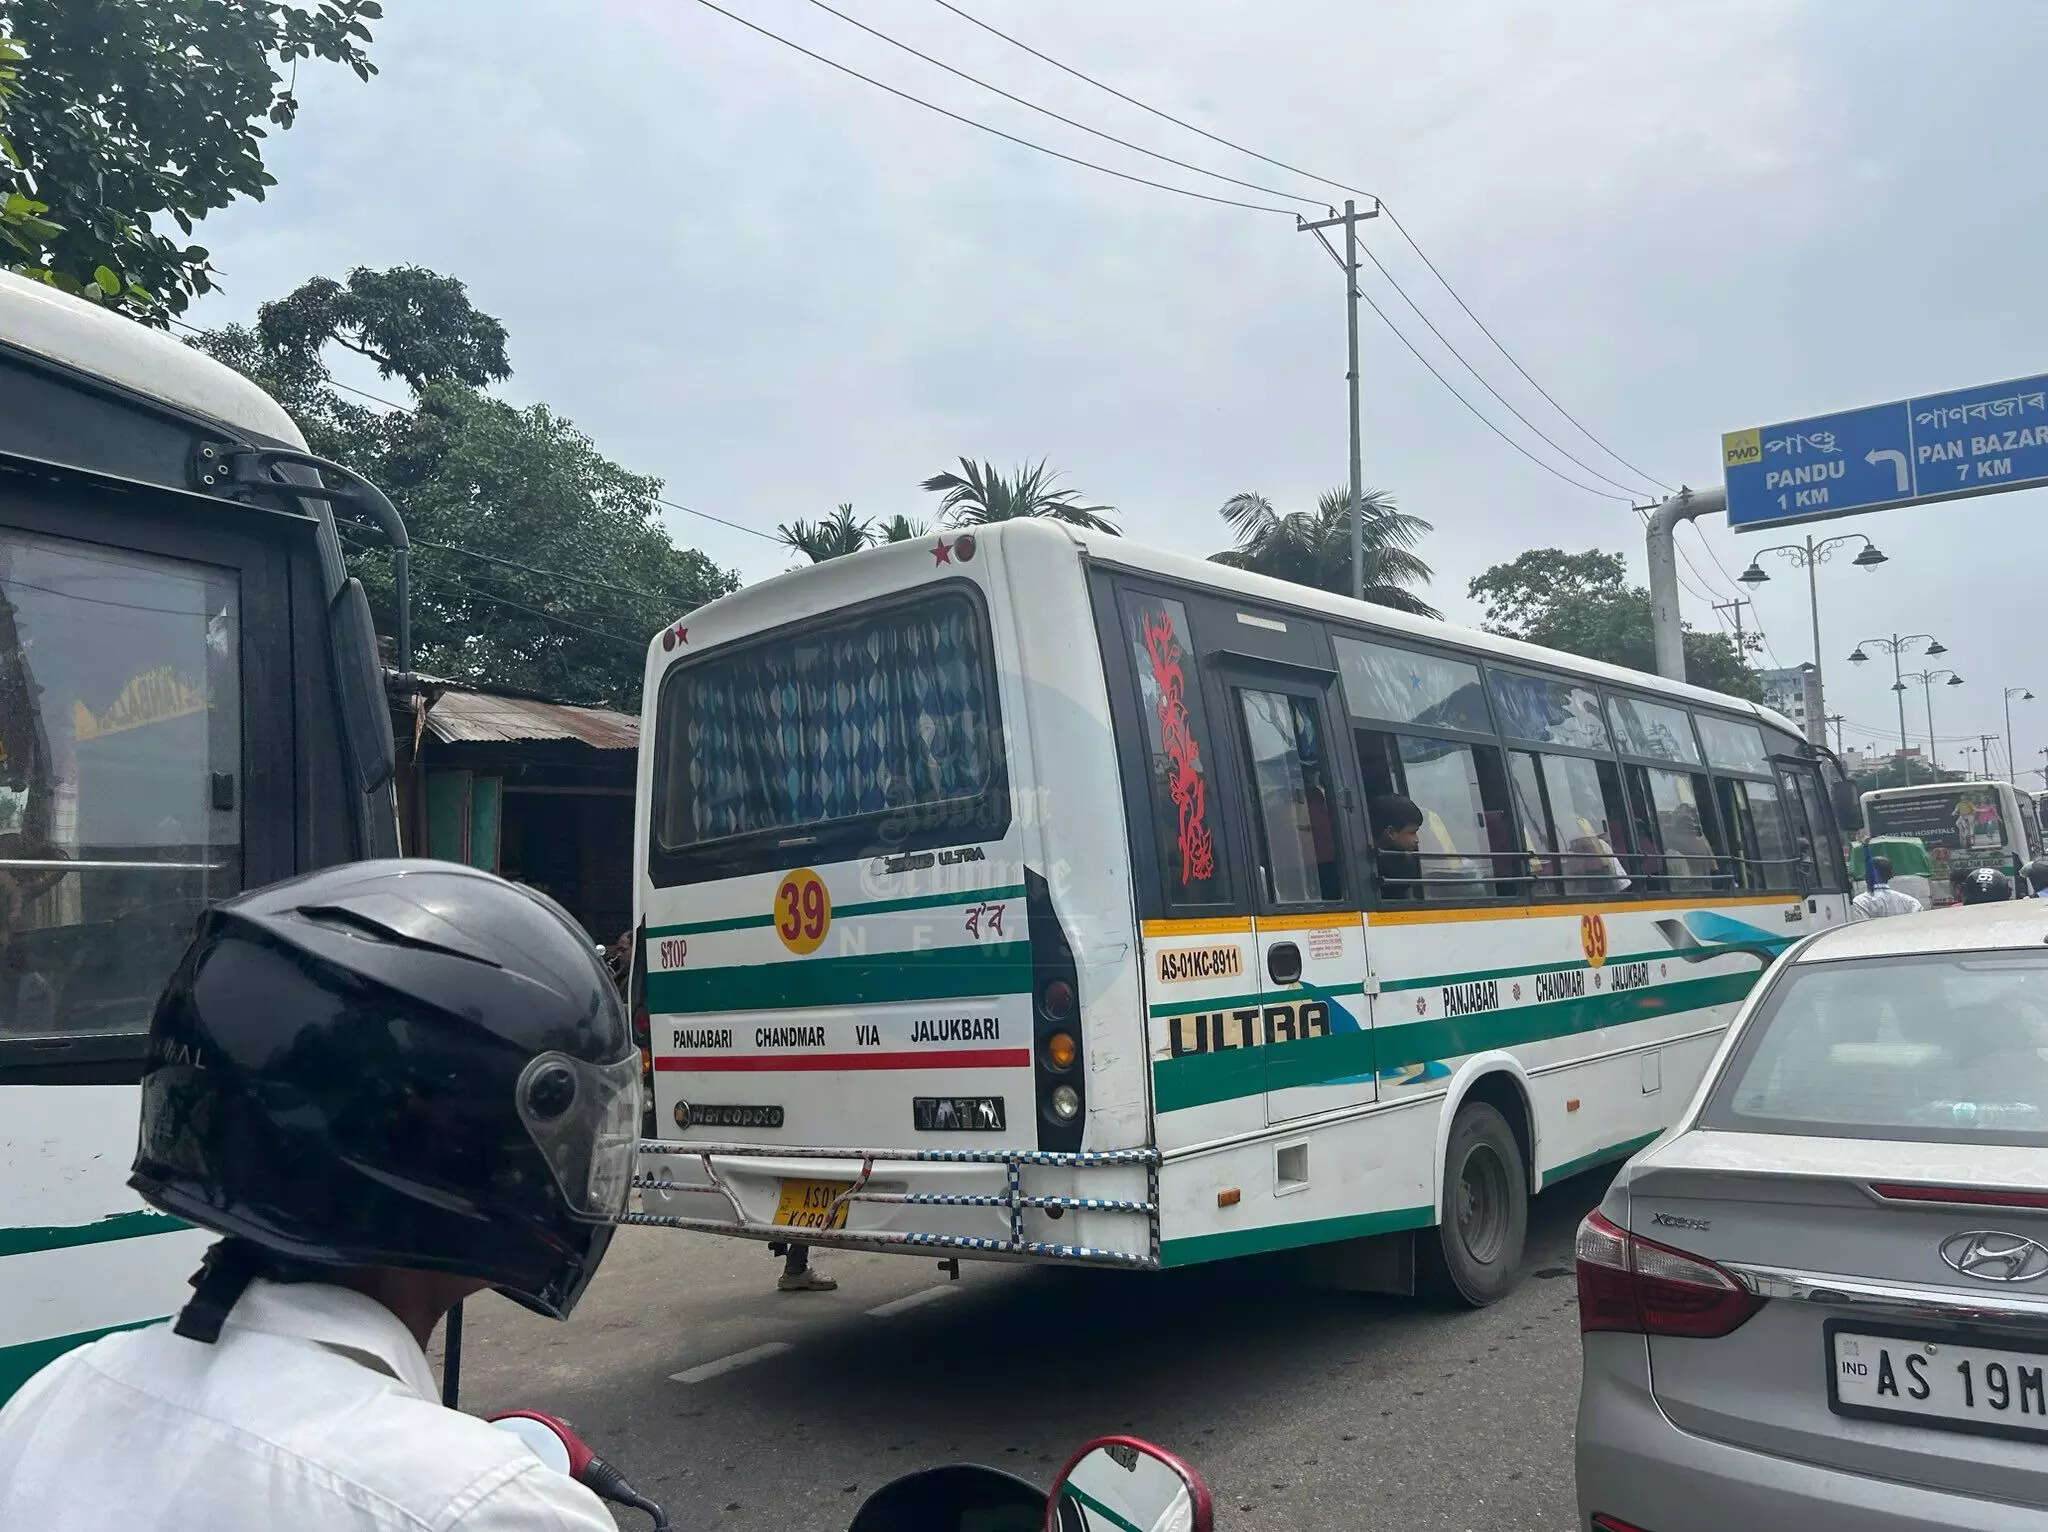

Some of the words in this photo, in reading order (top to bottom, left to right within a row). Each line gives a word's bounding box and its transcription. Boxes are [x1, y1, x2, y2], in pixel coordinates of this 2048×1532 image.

[1727, 446, 1759, 462] PWD
[1918, 440, 1964, 465] PAN
[1970, 425, 2048, 456] BAZAR
[1766, 460, 1846, 490] PANDU
[1956, 464, 1970, 482] 7
[1977, 457, 2012, 479] KM
[1777, 494, 1787, 511] 1
[1796, 488, 1829, 507] KM
[938, 846, 986, 866] ULTRA
[780, 880, 825, 941] 39
[1582, 914, 1605, 958] 39
[661, 939, 687, 969] STOP
[1161, 948, 1238, 980] AS-01KC-8911
[1442, 980, 1499, 1018] PANJABARI
[1535, 970, 1585, 1003] CHANDMARI
[1611, 962, 1649, 991] JALUKBARI
[673, 1024, 732, 1049] PANJABARI
[755, 1025, 825, 1048] CHANDMAR
[855, 1025, 880, 1046] VIA
[911, 1017, 1000, 1042] JALUKBARI
[1169, 1002, 1330, 1060] ULTRA
[916, 1099, 1002, 1128] TATA
[1842, 1361, 1868, 1376] IND
[1877, 1349, 1931, 1400] AS
[1956, 1359, 2048, 1416] 19M
